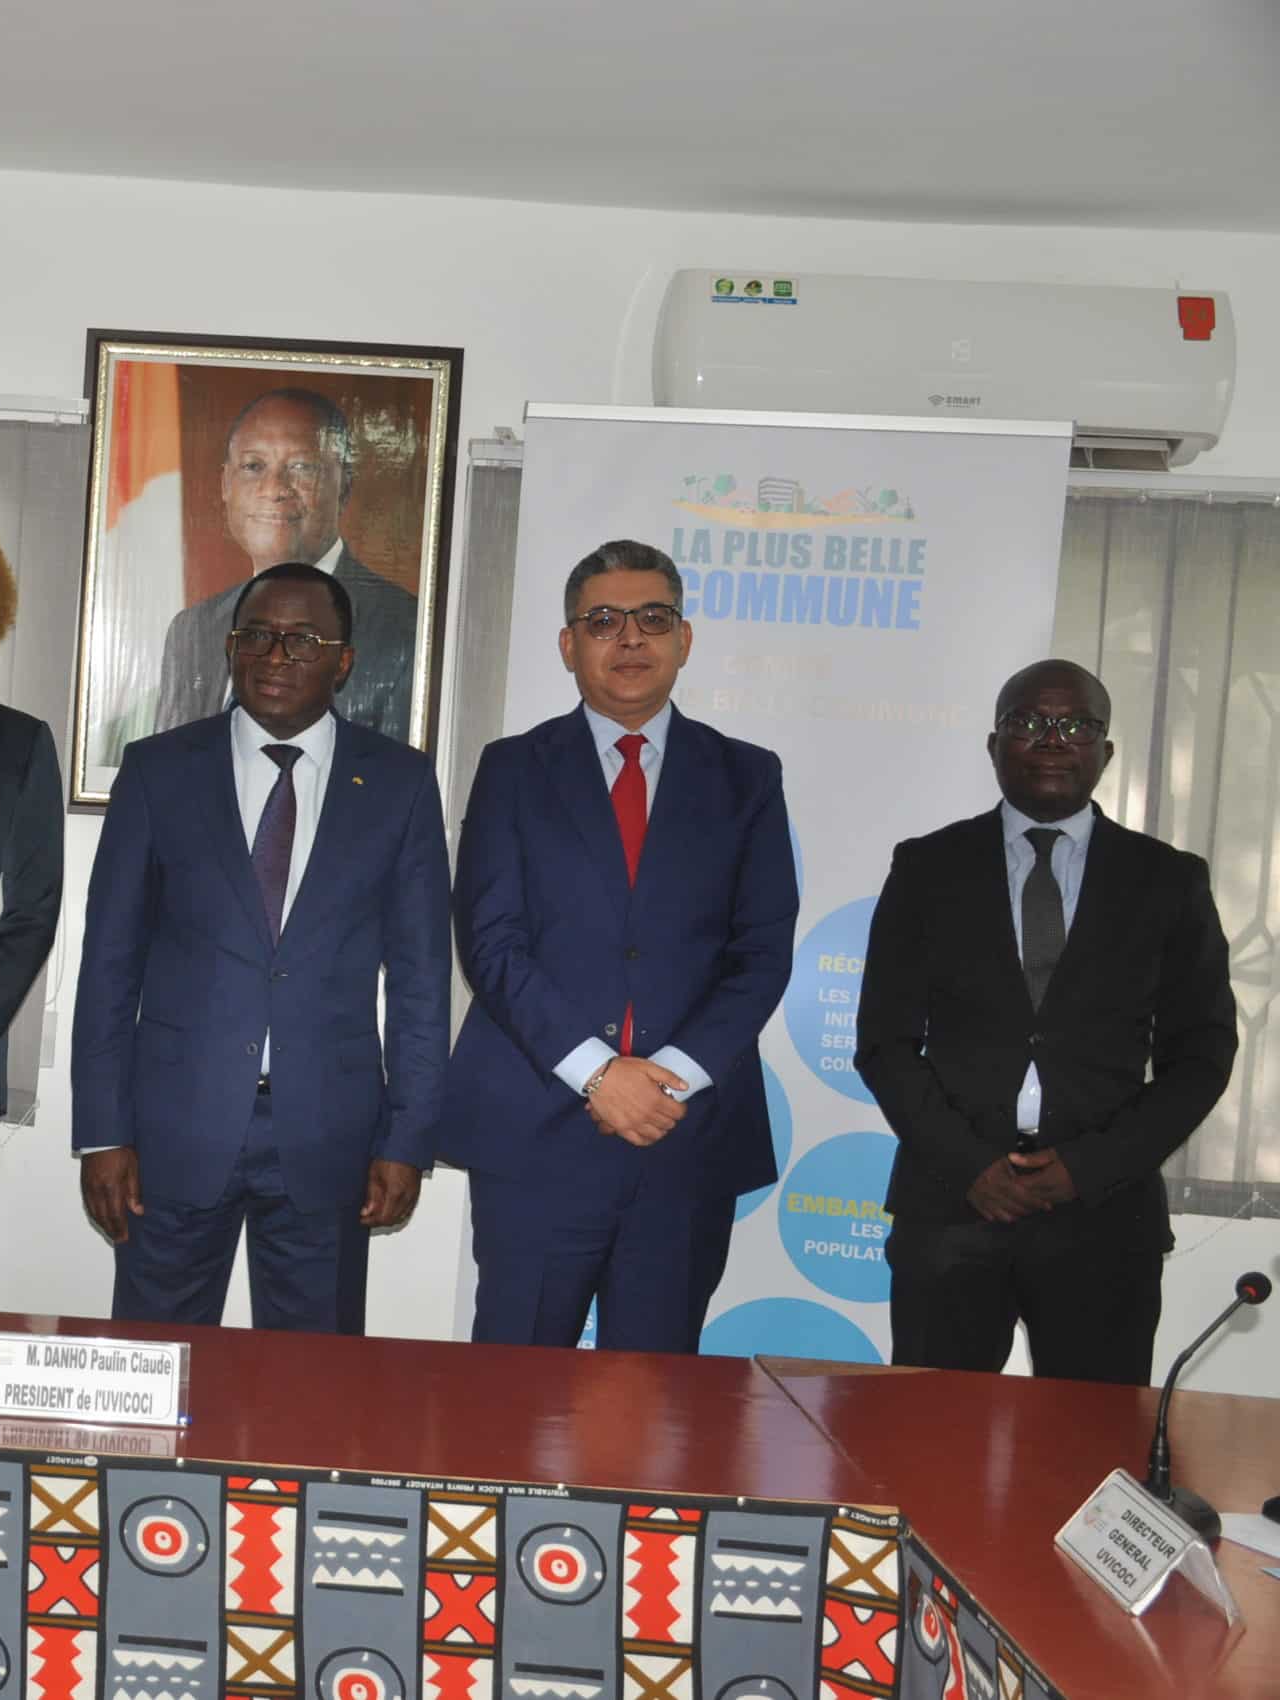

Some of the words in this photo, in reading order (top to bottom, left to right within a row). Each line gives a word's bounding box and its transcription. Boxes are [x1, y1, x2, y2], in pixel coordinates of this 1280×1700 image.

[673, 527, 712, 564] LA
[722, 529, 813, 569] PLUS
[823, 535, 928, 576] BELLE
[679, 567, 923, 631] COMMUNE
[818, 953, 866, 974] RÉC
[819, 987, 850, 1004] LES
[825, 1011, 857, 1028] INIT
[821, 1033, 857, 1048] SER
[850, 1222, 884, 1239] LES
[804, 1240, 885, 1262] POPULAT
[26, 1344, 40, 1367] M.
[44, 1345, 87, 1370] DANHO
[90, 1349, 127, 1373] Paulin
[130, 1352, 172, 1376] Claude
[4, 1383, 74, 1408] PRESIDENT
[77, 1391, 91, 1411] de
[94, 1391, 153, 1415] l'UVICOCI
[1108, 1528, 1153, 1571] GENERAL
[1121, 1508, 1176, 1560] DIRECTEUR
[1095, 1547, 1138, 1589] UVICOCI
